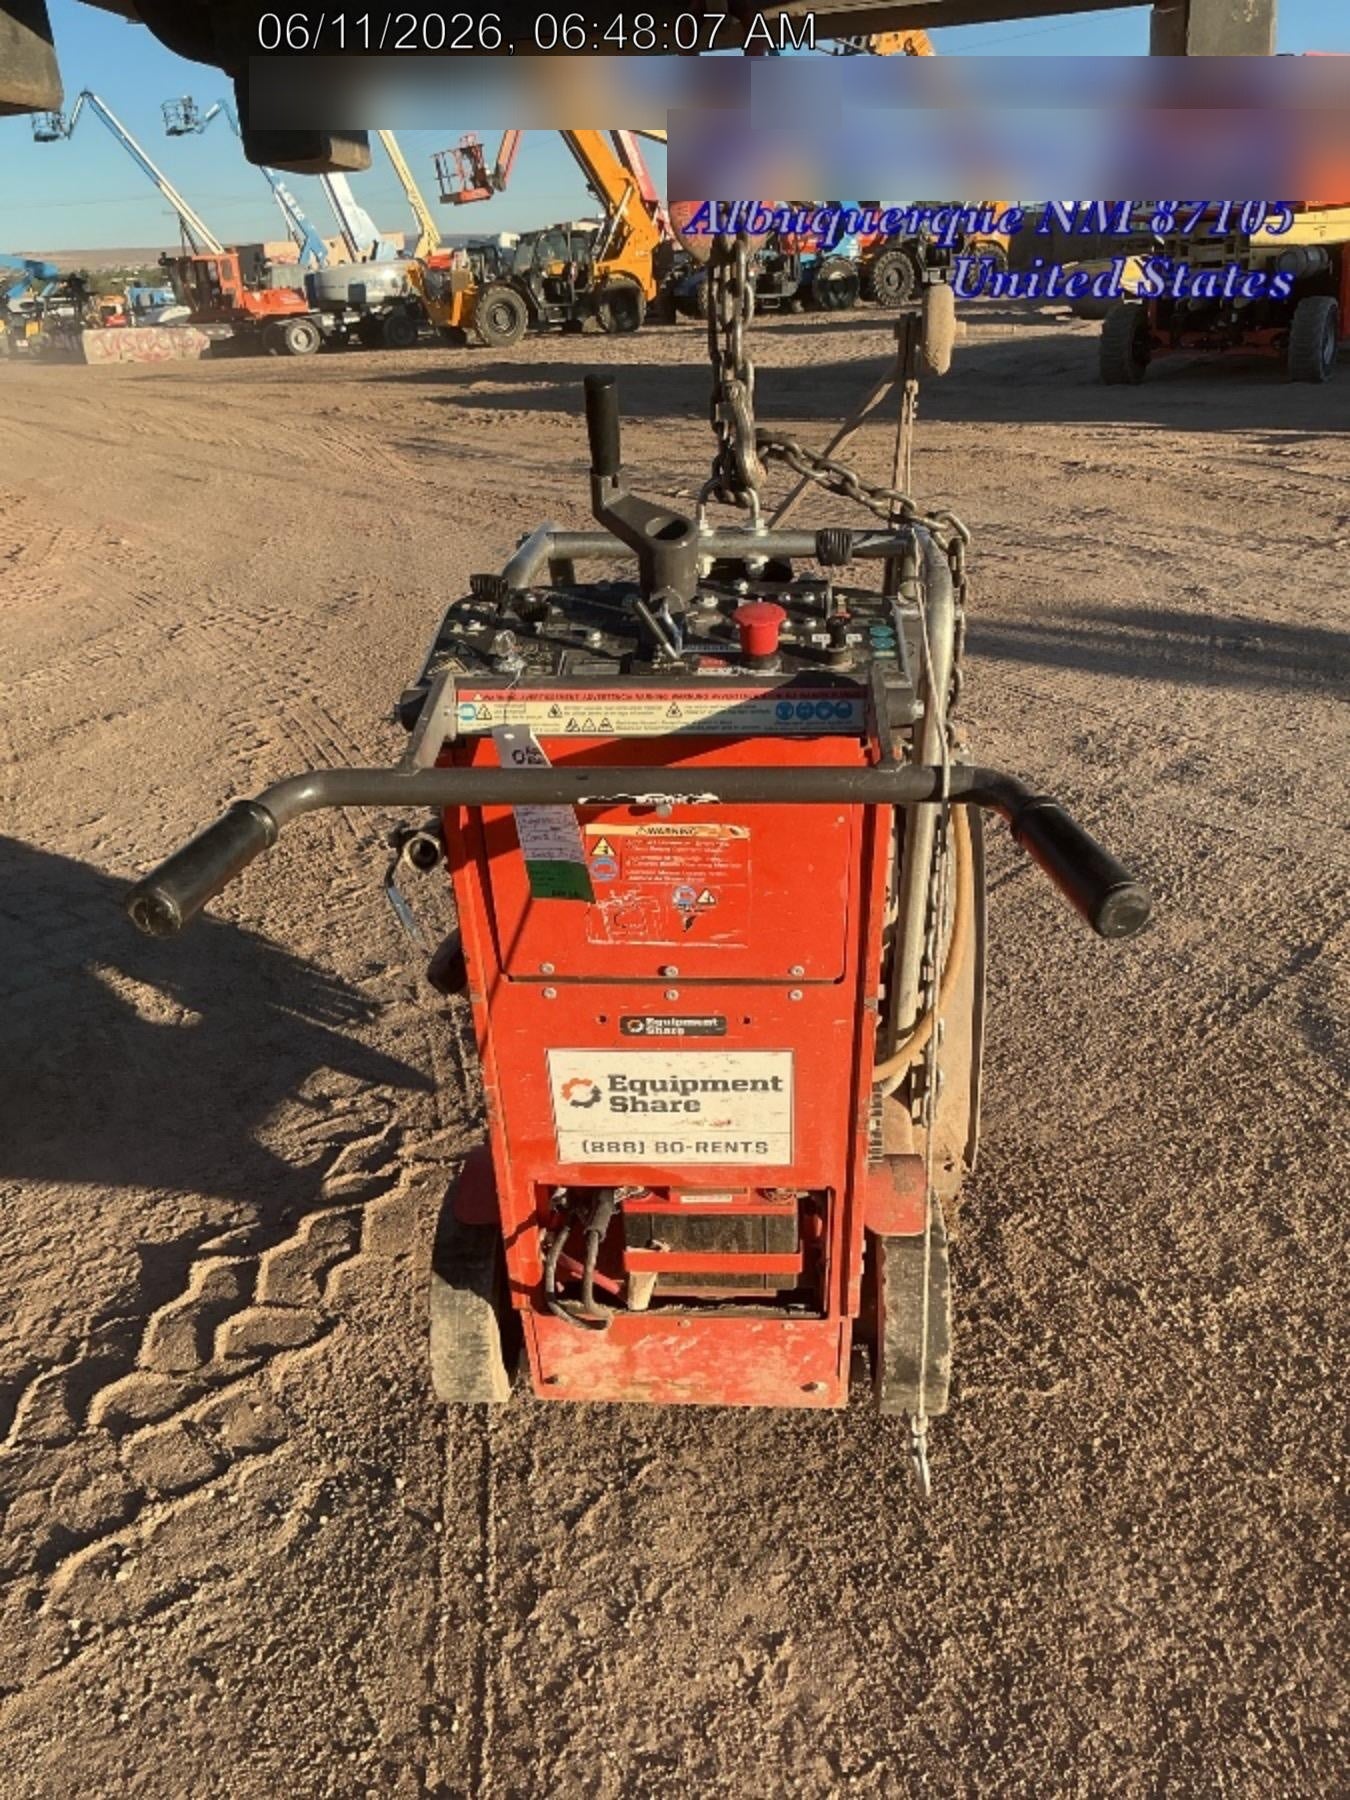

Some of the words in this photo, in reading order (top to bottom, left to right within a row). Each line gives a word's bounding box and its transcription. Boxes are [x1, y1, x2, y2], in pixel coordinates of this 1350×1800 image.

[645, 1017, 719, 1027] Equipment
[645, 1027, 686, 1036] Share
[607, 1074, 783, 1096] Equipment
[609, 1095, 701, 1113] Share
[582, 1140, 646, 1155] (888)
[654, 1140, 769, 1154] 80-RENTS
